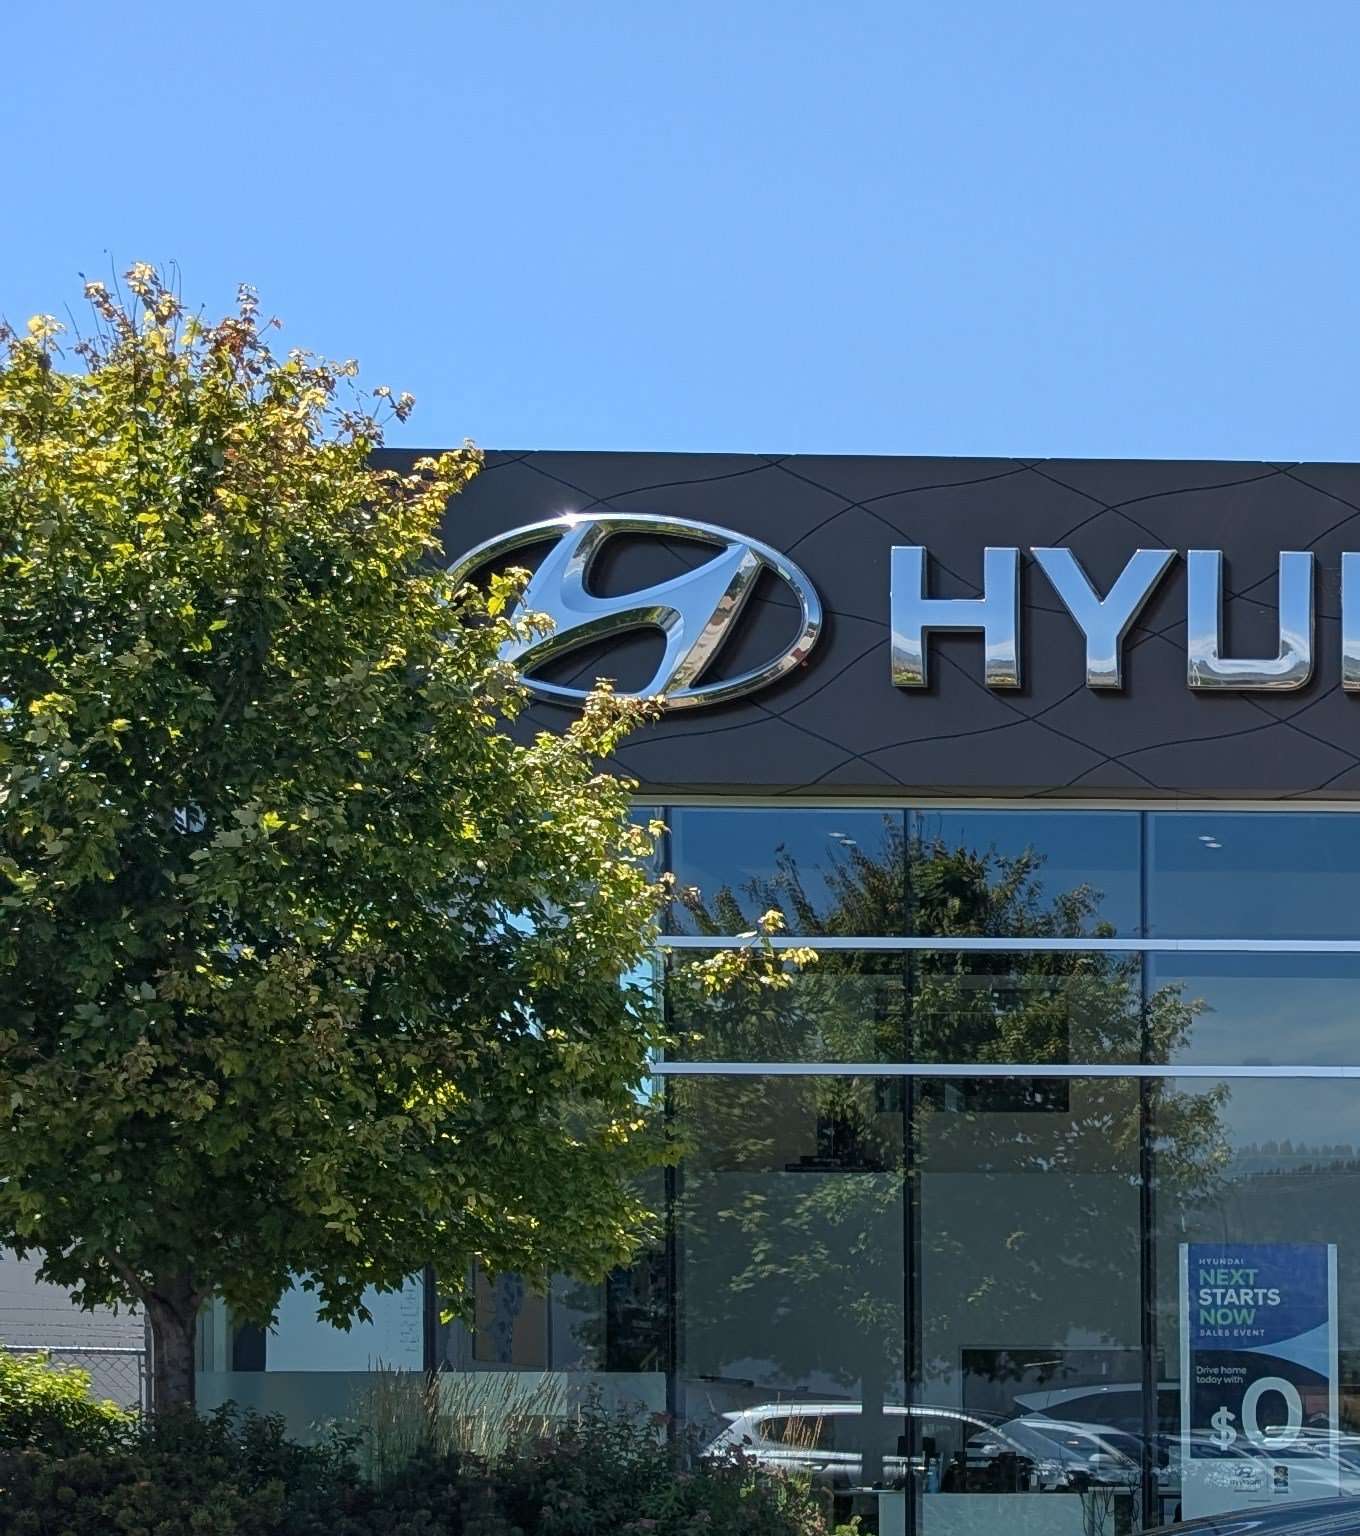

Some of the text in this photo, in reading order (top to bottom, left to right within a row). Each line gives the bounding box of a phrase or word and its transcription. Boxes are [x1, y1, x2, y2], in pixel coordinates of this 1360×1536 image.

[1200, 1269, 1258, 1285] NEXT
[1199, 1288, 1281, 1306] STARTS
[1200, 1308, 1257, 1326] NOW
[1200, 1329, 1265, 1337] SALES EVENT
[1196, 1366, 1247, 1375] Drive home
[1196, 1376, 1244, 1385] today with
